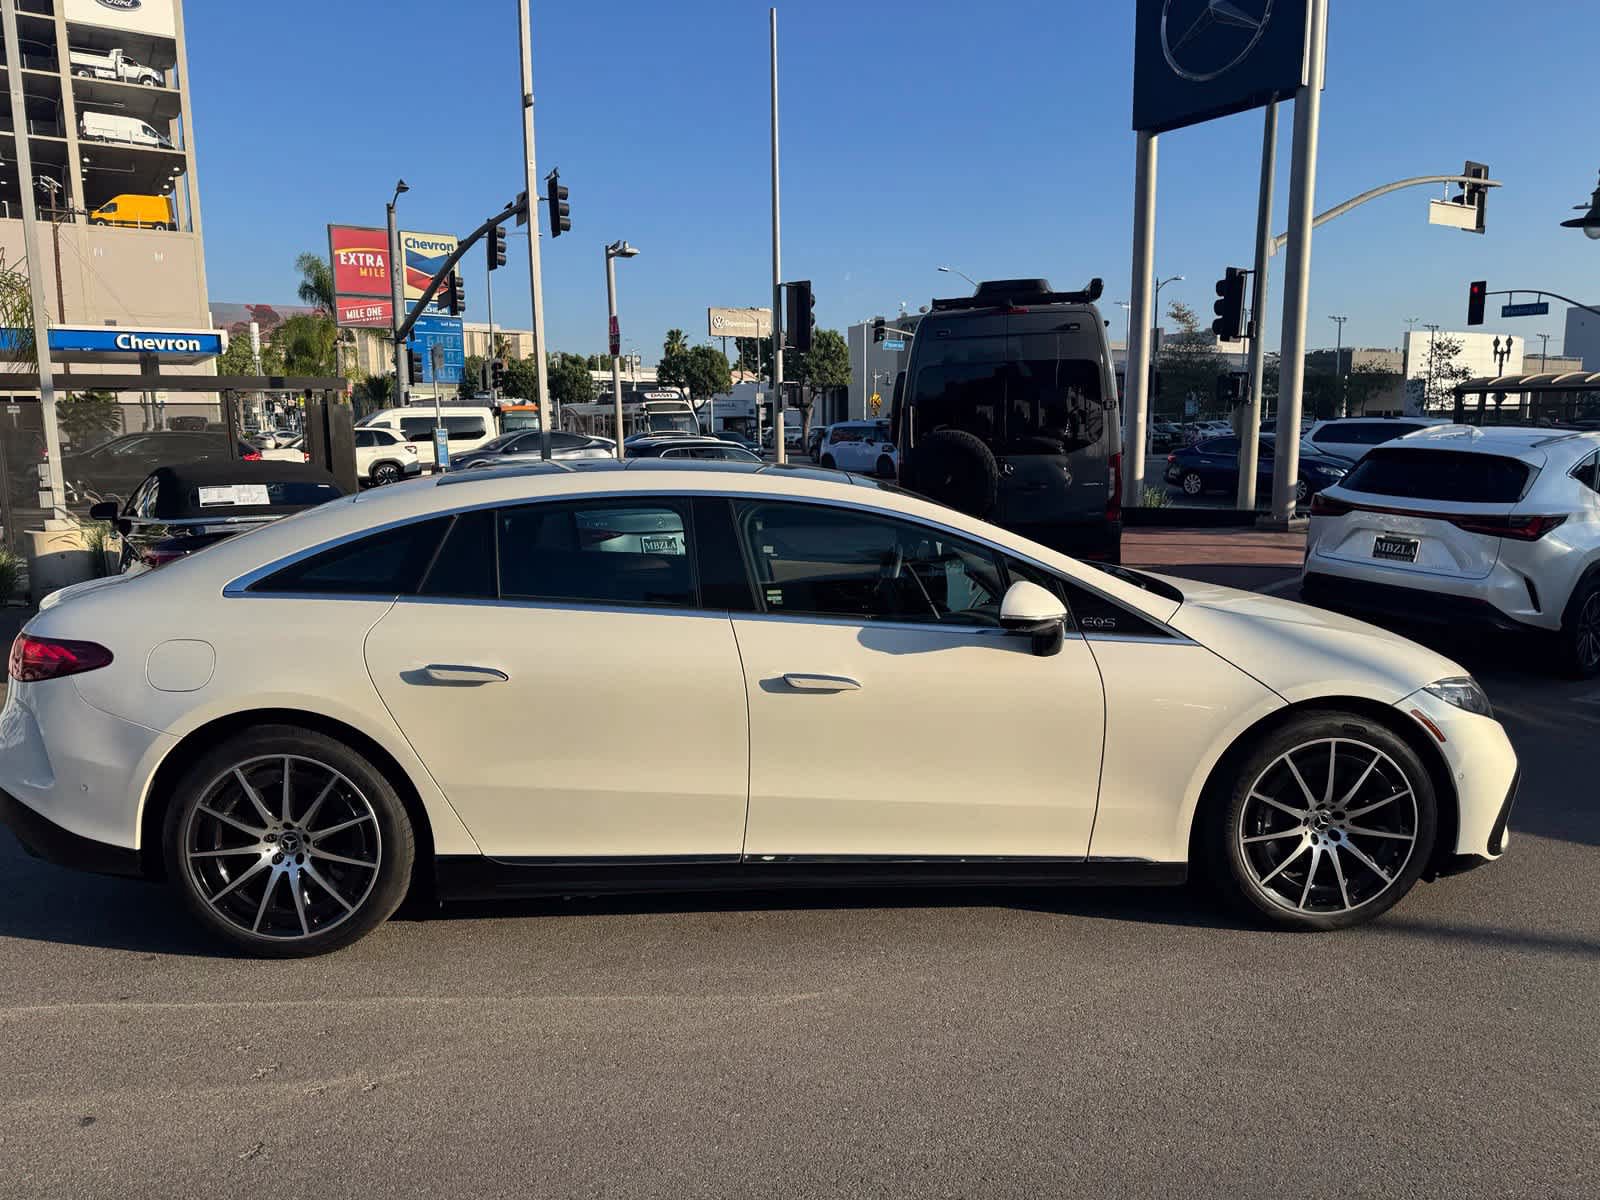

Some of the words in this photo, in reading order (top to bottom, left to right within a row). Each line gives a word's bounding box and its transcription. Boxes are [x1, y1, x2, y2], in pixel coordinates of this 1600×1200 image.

[404, 237, 454, 252] Chevron
[340, 252, 384, 267] EXTRA
[360, 267, 385, 278] MILE
[345, 309, 365, 320] MILE
[366, 306, 383, 317] ONE
[116, 333, 200, 351] Chevron
[645, 540, 677, 551] MBZLA
[1375, 542, 1416, 555] MBZLA
[1081, 616, 1116, 628] EQS
